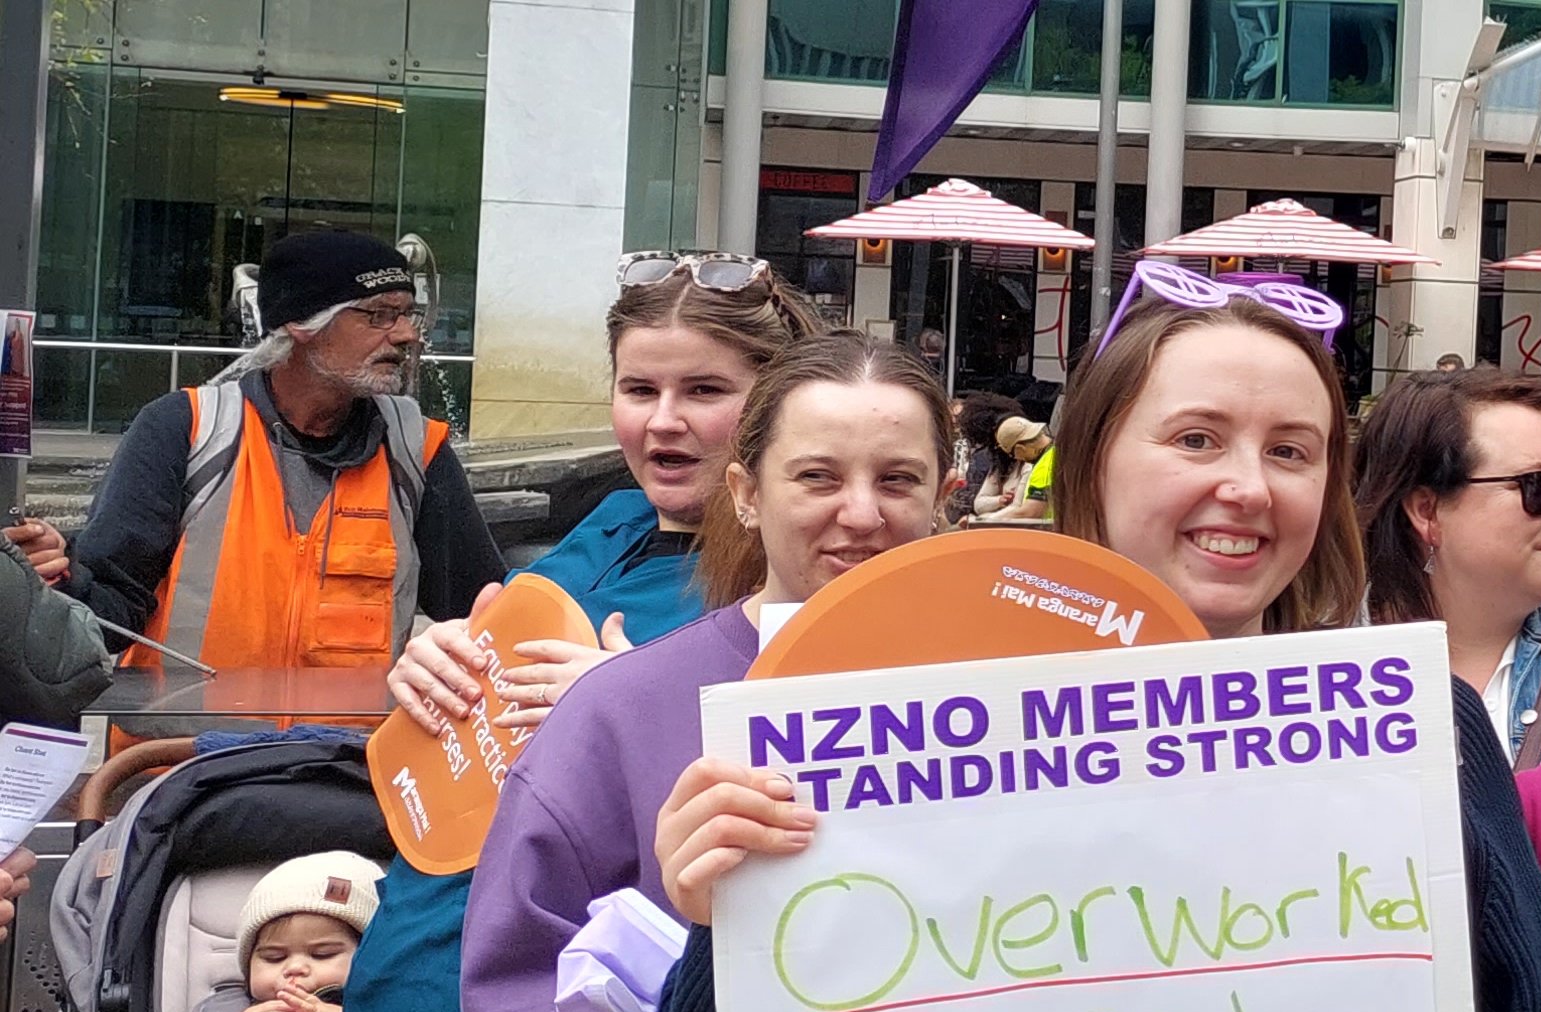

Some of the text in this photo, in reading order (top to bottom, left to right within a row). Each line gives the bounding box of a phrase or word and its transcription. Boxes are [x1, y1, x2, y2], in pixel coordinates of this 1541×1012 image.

[1037, 597, 1145, 646] Maranga
[747, 656, 1415, 768] NZNO MEMBERS
[786, 712, 1419, 813] TANDING STRONG
